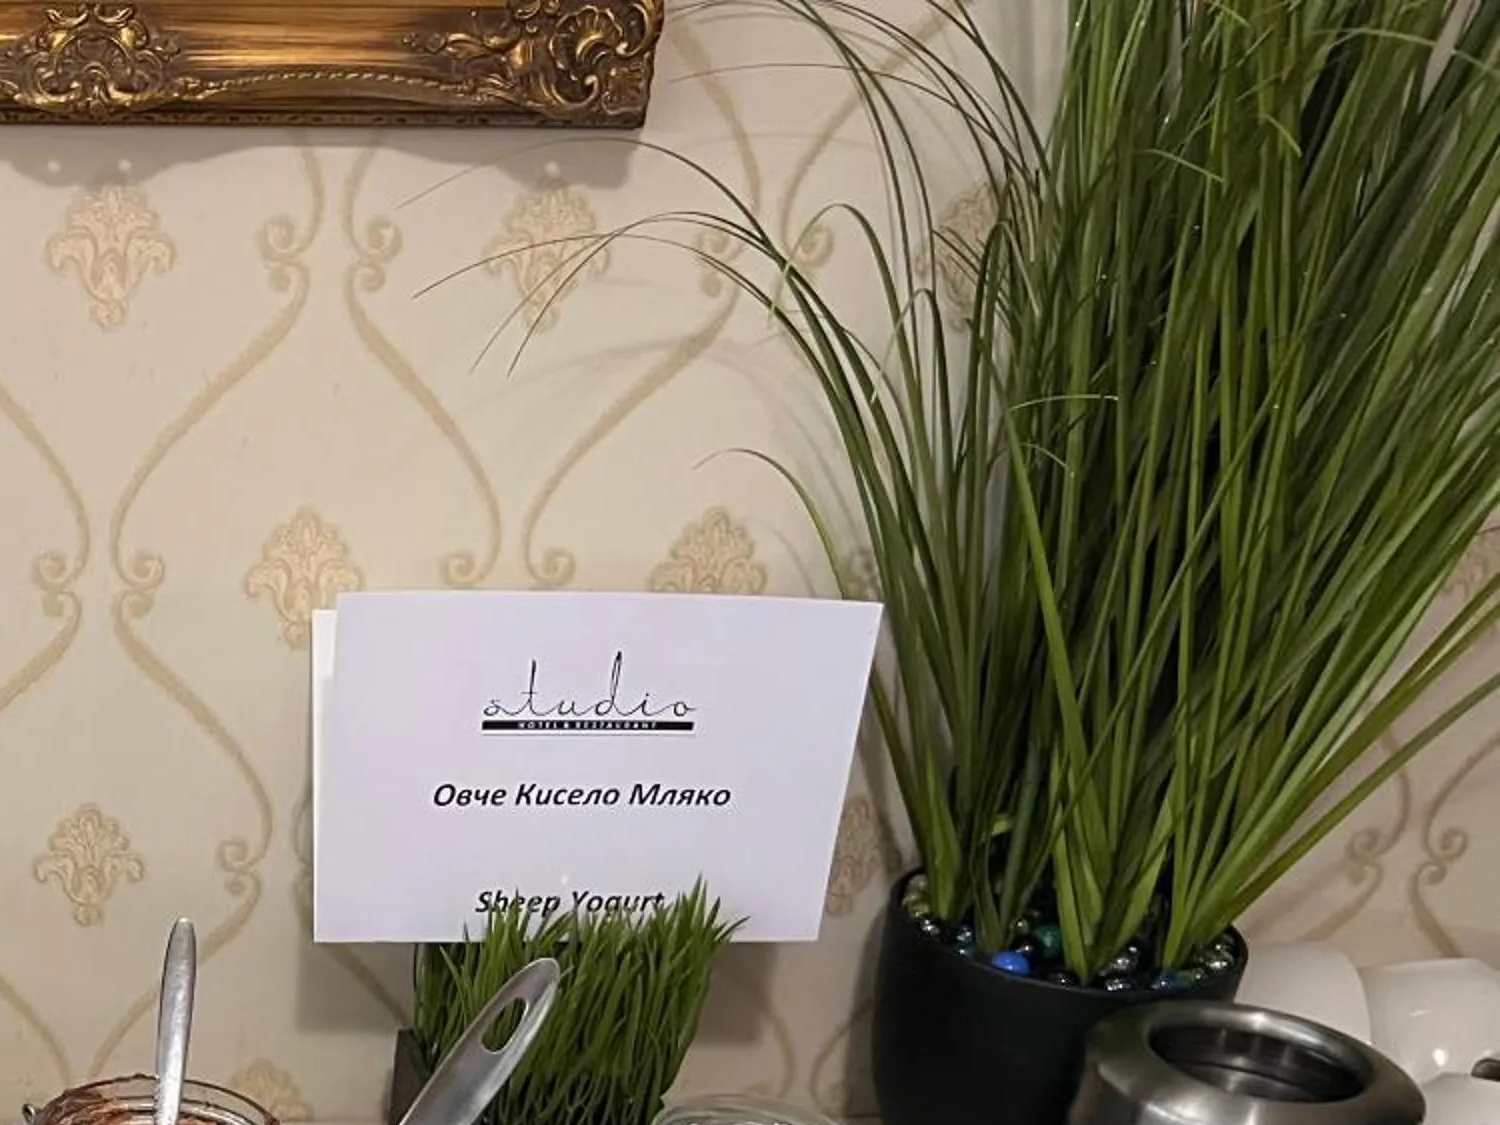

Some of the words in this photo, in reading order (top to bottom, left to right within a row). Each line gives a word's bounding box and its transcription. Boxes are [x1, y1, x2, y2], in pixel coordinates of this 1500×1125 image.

[484, 651, 696, 717] studio
[517, 720, 558, 730] HOTEL
[575, 720, 658, 730] RESTAURANT
[433, 783, 507, 806] Овче
[515, 783, 621, 806] Кисело
[628, 783, 732, 806] Мляко
[475, 890, 561, 917] Sheep
